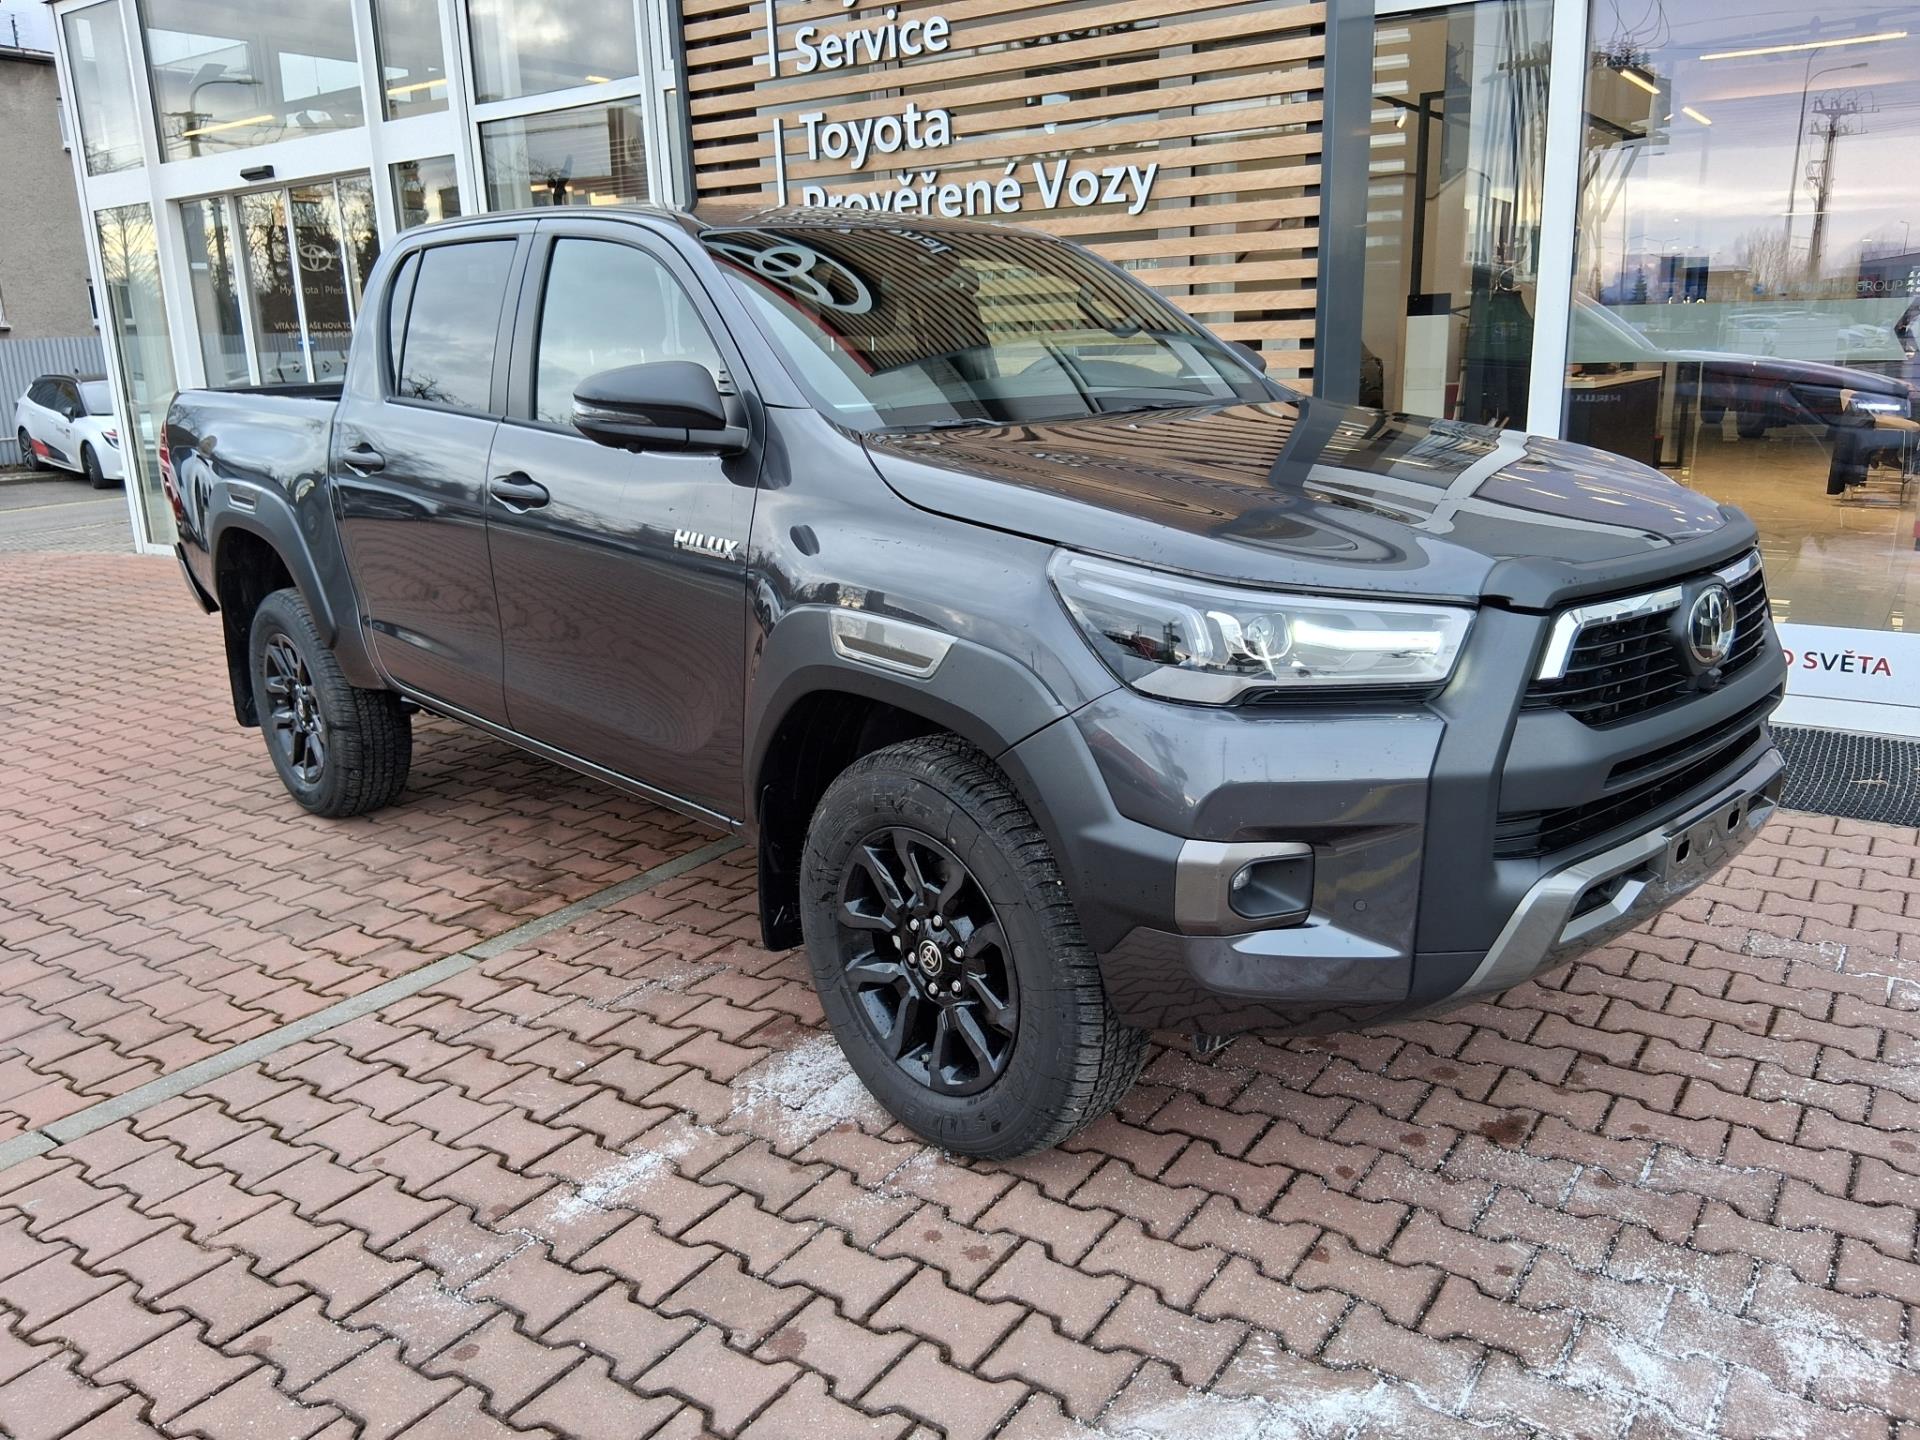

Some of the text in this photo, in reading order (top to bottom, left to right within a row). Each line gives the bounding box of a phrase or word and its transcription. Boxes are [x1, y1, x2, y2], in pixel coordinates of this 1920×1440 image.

[795, 8, 950, 73] Service
[799, 102, 952, 170] Toyota
[1031, 159, 1159, 216] Vozy
[280, 284, 318, 295] Myota
[673, 528, 740, 561] HILUX
[1802, 649, 1892, 677] SVĚTA
